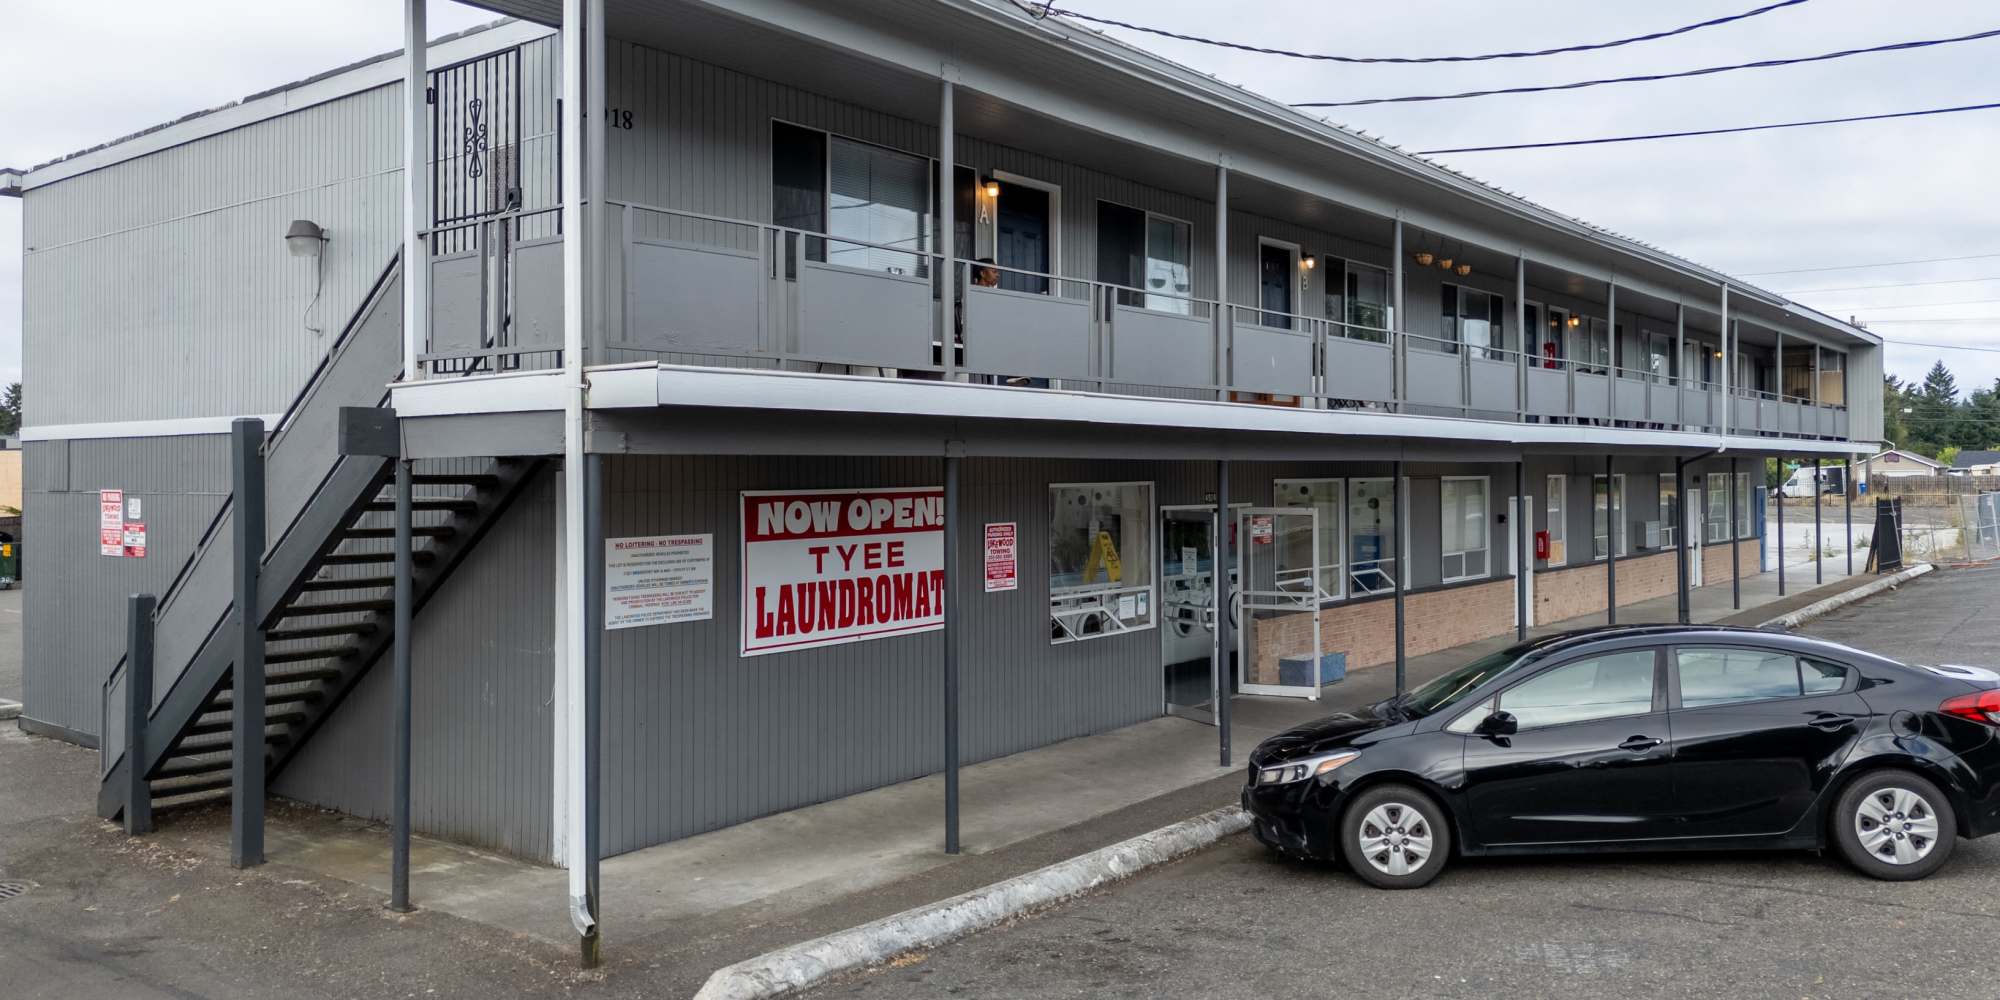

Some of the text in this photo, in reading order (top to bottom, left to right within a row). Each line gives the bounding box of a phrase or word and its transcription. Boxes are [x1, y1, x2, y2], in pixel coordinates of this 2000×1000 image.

[980, 204, 990, 224] A
[757, 496, 944, 536] NOW OPEN!
[808, 541, 905, 574] TYEE
[755, 569, 945, 639] LAUNDROMAT
